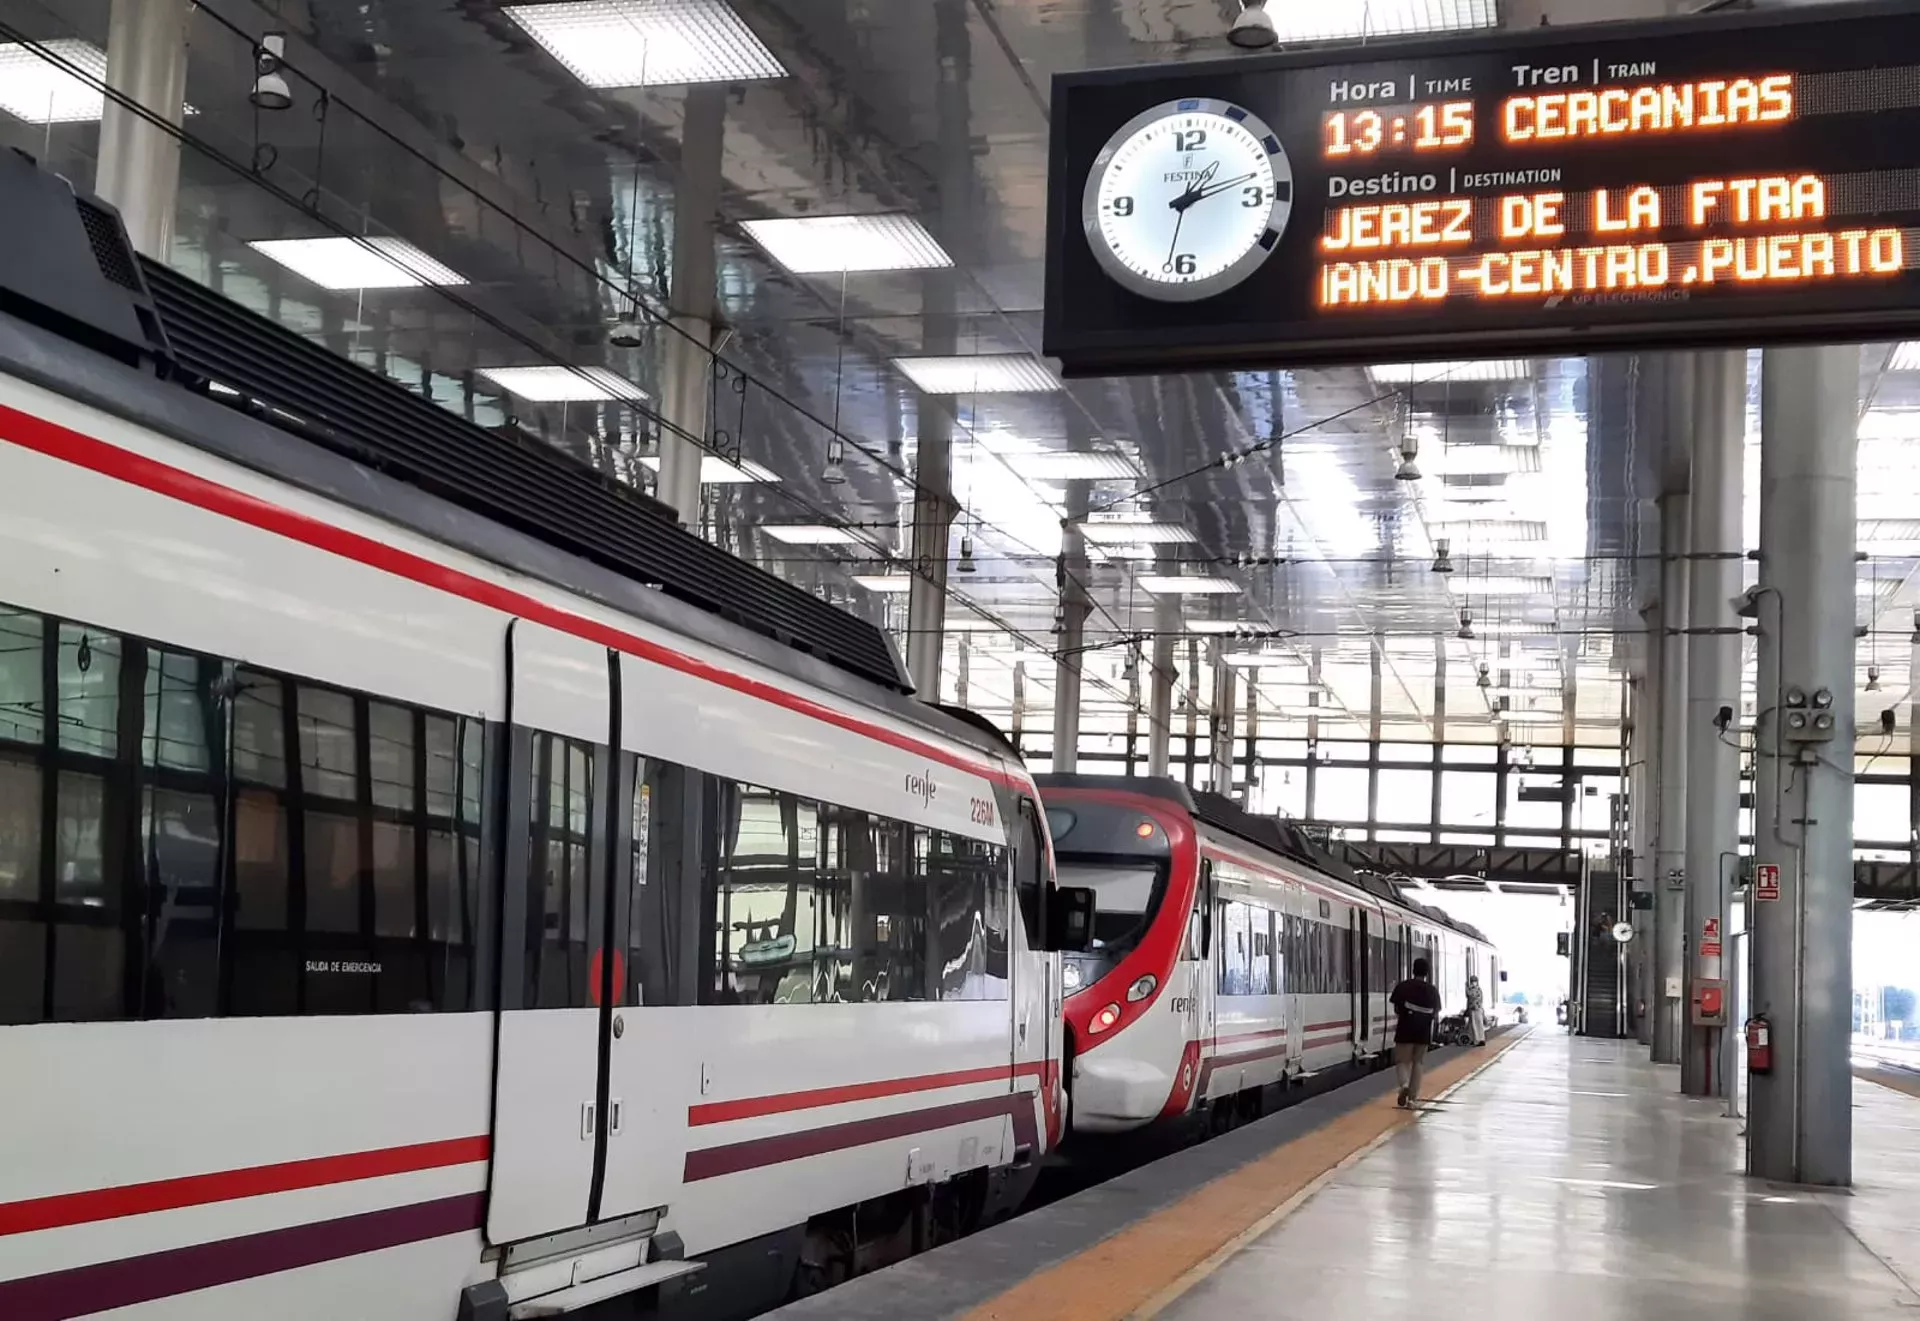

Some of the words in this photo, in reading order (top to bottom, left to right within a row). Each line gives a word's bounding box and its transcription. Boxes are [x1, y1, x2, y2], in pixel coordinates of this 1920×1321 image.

[1512, 65, 1579, 86] Tren
[1608, 62, 1656, 78] TRAIN
[1330, 80, 1396, 102] Hora
[1425, 77, 1473, 94] TIME
[1505, 75, 1792, 140] CERCANIAS
[1327, 102, 1473, 155] 13:15
[1172, 130, 1207, 152] 12
[1328, 174, 1436, 197] Destino
[1464, 168, 1561, 188] DESTINATION
[1113, 196, 1133, 217] 9
[1241, 186, 1263, 208] 3
[1323, 199, 1471, 249] JEREZ
[1503, 192, 1564, 238] DE
[1597, 186, 1660, 231] LA
[1691, 174, 1824, 225] FTRA
[1175, 254, 1196, 274] 6
[905, 768, 936, 809] renfe
[330, 961, 340, 972] DE
